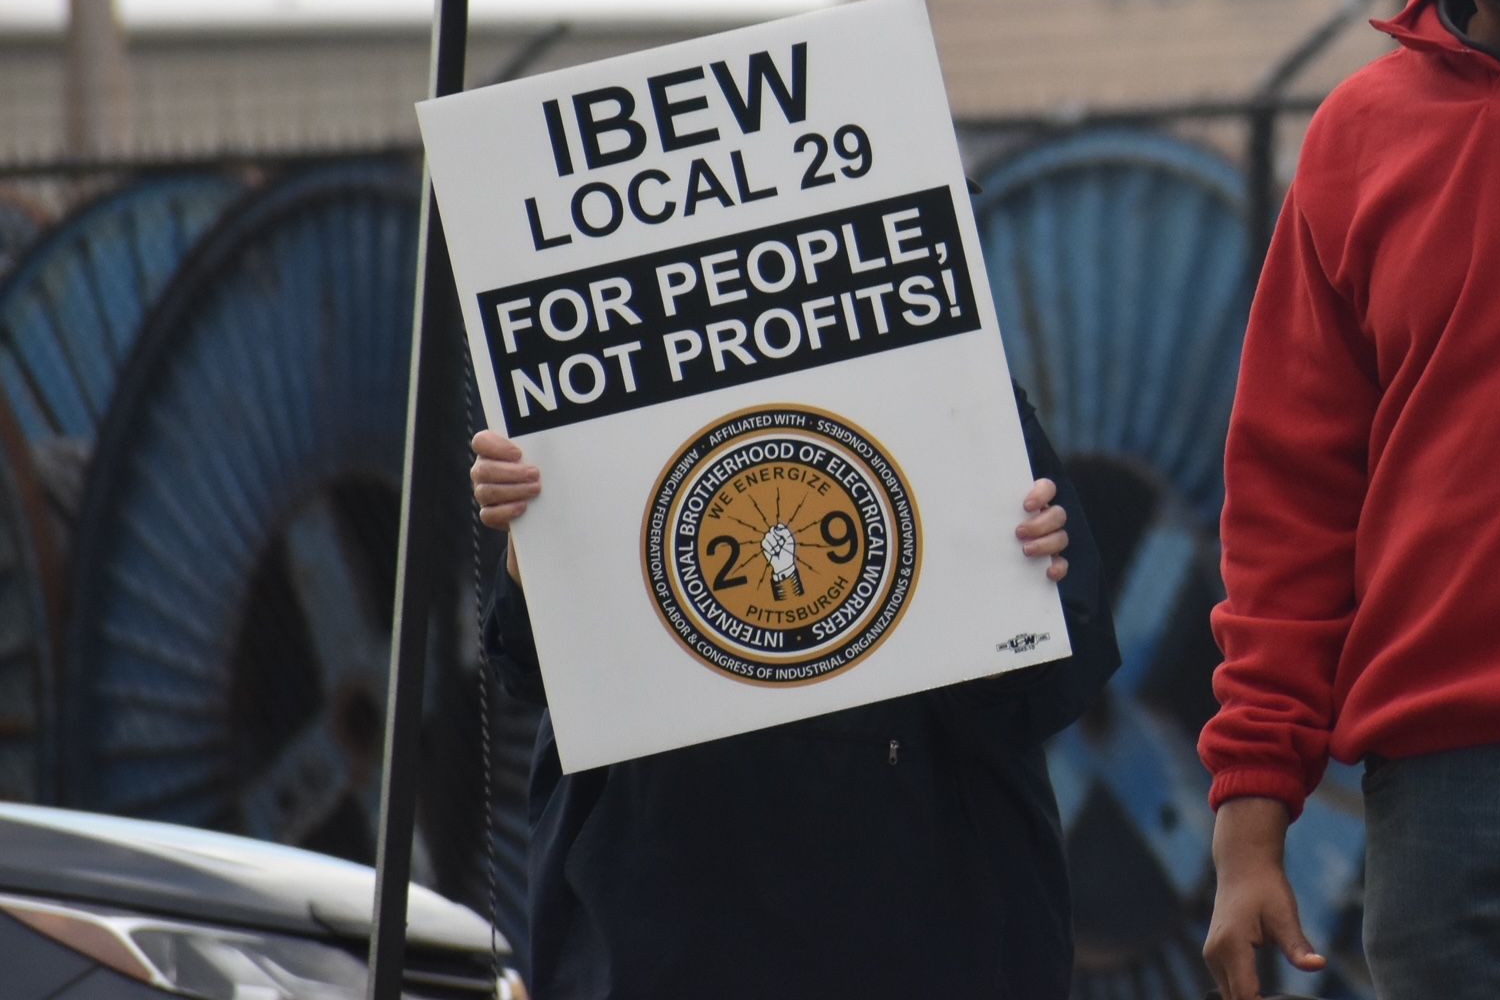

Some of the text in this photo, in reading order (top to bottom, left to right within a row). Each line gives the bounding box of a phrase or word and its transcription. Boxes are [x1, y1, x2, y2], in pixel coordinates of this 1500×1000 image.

[543, 42, 807, 176] IBEW
[525, 125, 872, 251] LOCAL 29
[497, 208, 947, 353] FOR PEOPLE,
[511, 268, 963, 417] NOT PROFITS!
[708, 466, 831, 519] WE ENERGIZE
[709, 414, 805, 446] AFFILIATED WITH
[650, 419, 913, 679] AMERICAN FEDERATION OF LABOR & CONGRESS OF INDUSTRIAL ORGANIZATIONS & CANADIAN LABOUR CONGRESS
[678, 442, 884, 648] INTERNATIONAL BROTHERHOOD OF ELECTRICAL WORKERS
[706, 510, 859, 591] 2 9
[745, 575, 849, 624] PITTSBURGH
